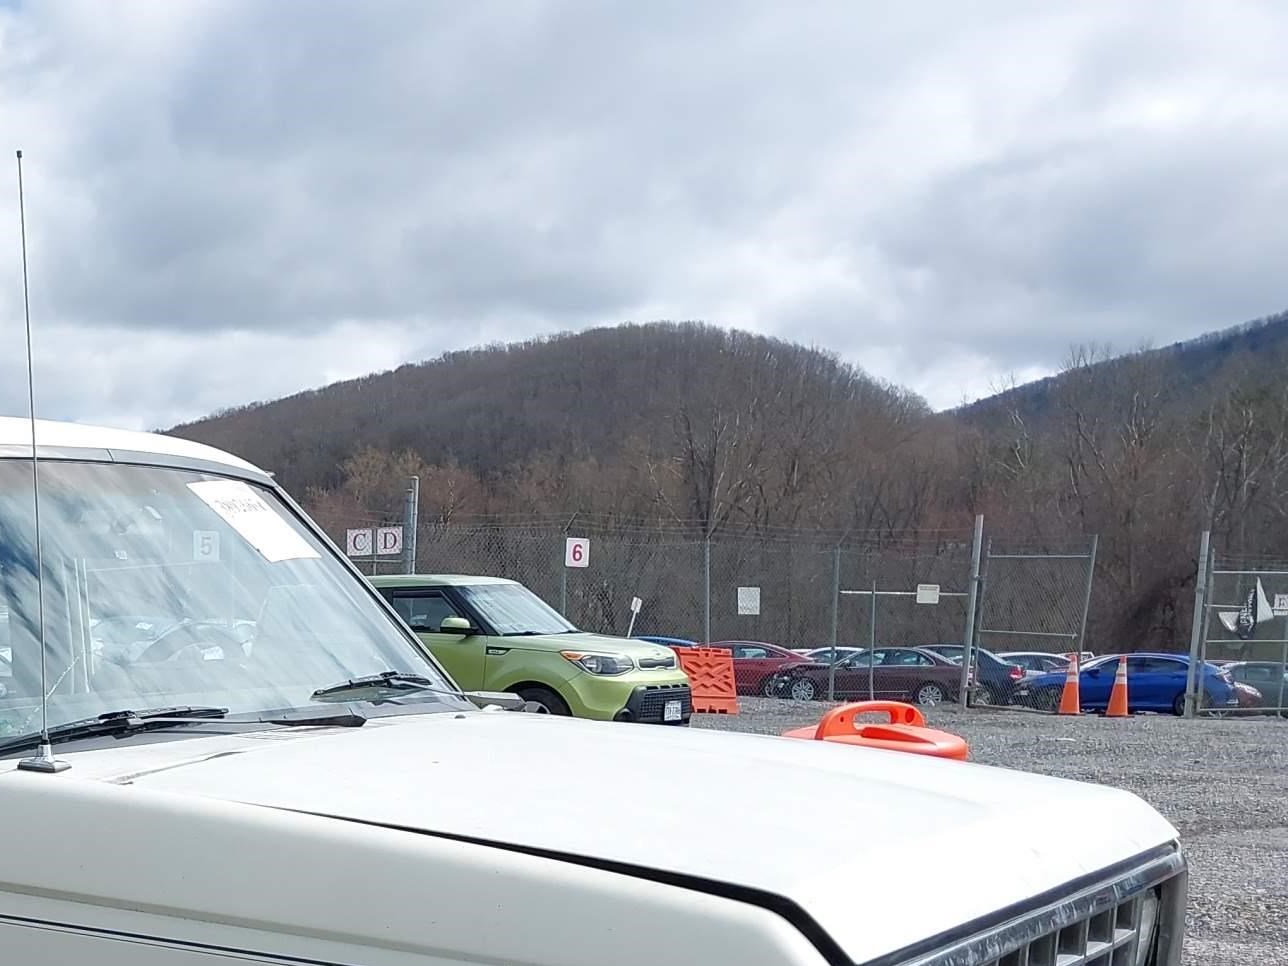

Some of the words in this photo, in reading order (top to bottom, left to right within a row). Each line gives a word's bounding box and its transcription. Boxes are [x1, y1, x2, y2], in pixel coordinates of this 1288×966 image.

[353, 533, 368, 551] C
[383, 532, 397, 550] D
[572, 543, 583, 562] 6
